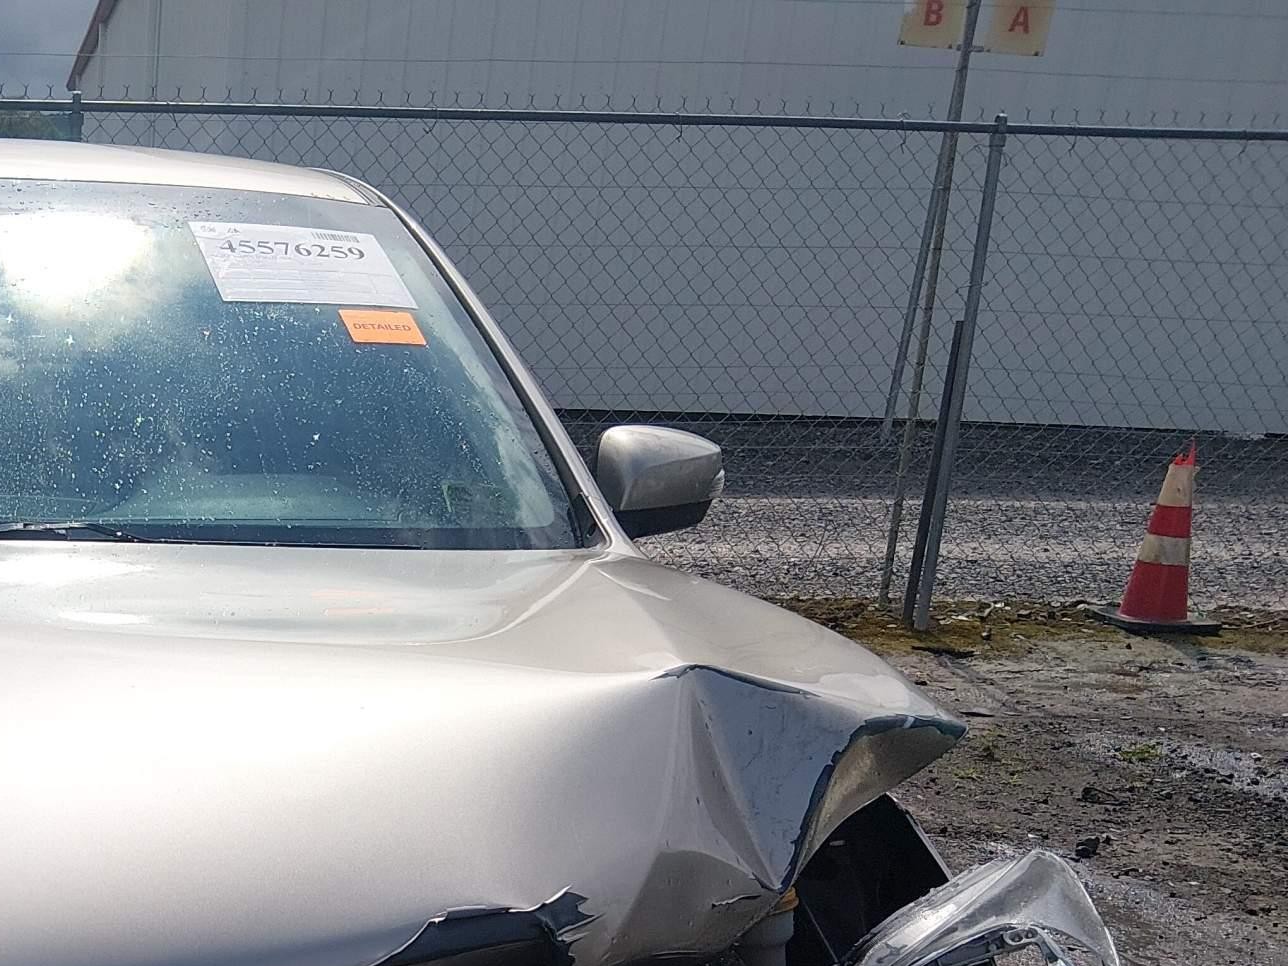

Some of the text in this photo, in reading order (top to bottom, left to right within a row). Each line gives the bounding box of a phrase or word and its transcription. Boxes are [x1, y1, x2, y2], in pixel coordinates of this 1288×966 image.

[923, 0, 944, 26] B
[1008, 6, 1030, 34] A
[219, 239, 366, 260] 45576259
[353, 322, 412, 333] DETAILED
